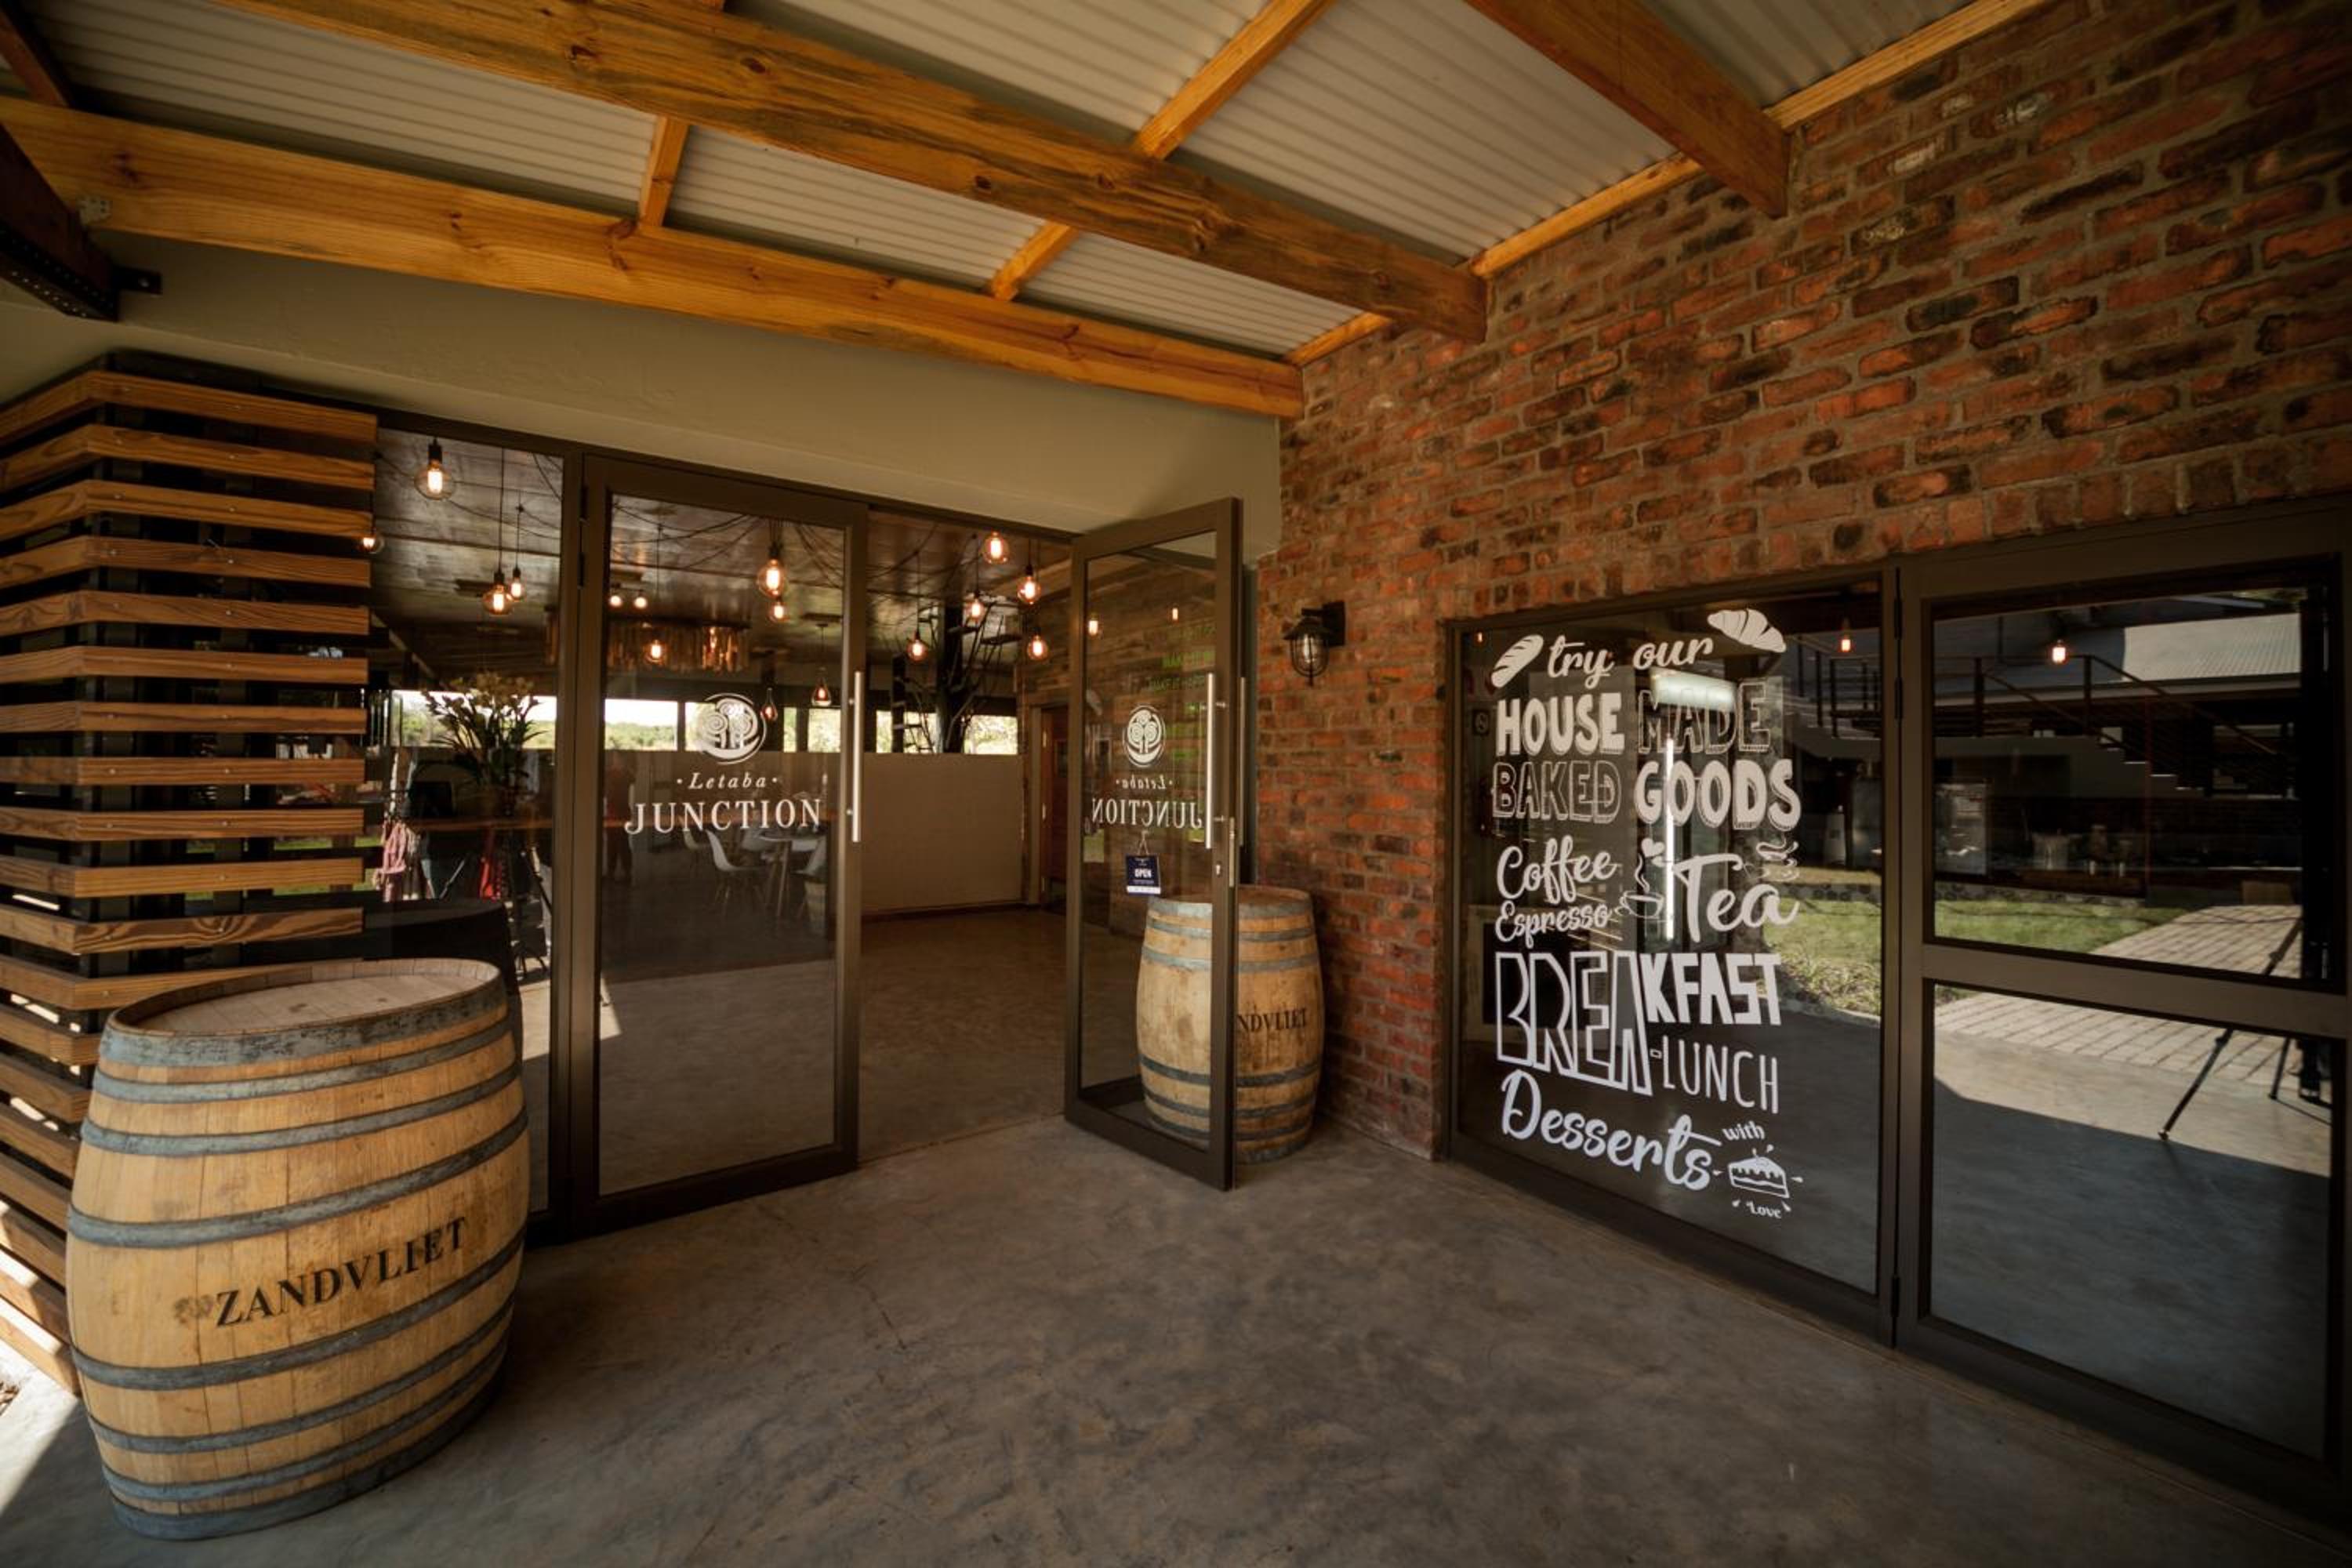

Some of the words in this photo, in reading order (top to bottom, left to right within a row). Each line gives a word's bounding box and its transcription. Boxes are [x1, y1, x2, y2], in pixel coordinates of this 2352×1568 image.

[1548, 635, 1615, 688] try
[1633, 637, 1714, 670] our
[1496, 692, 1625, 756] HOUSE
[1637, 681, 1771, 754] MADE
[624, 798, 821, 834] JUNCTION
[1492, 760, 1621, 824] BAKED
[1635, 759, 1802, 830] GOODS
[1497, 835, 1618, 905] Coffee
[1671, 852, 1800, 942] Tea
[1495, 900, 1612, 949] Espresso
[1236, 1007, 1307, 1033] NDVLIET
[1496, 950, 1781, 1095] BREAKFAST
[1501, 1069, 1722, 1189] Desserts
[1723, 1120, 1766, 1141] with
[216, 1218, 465, 1327] ZANDVLIET
